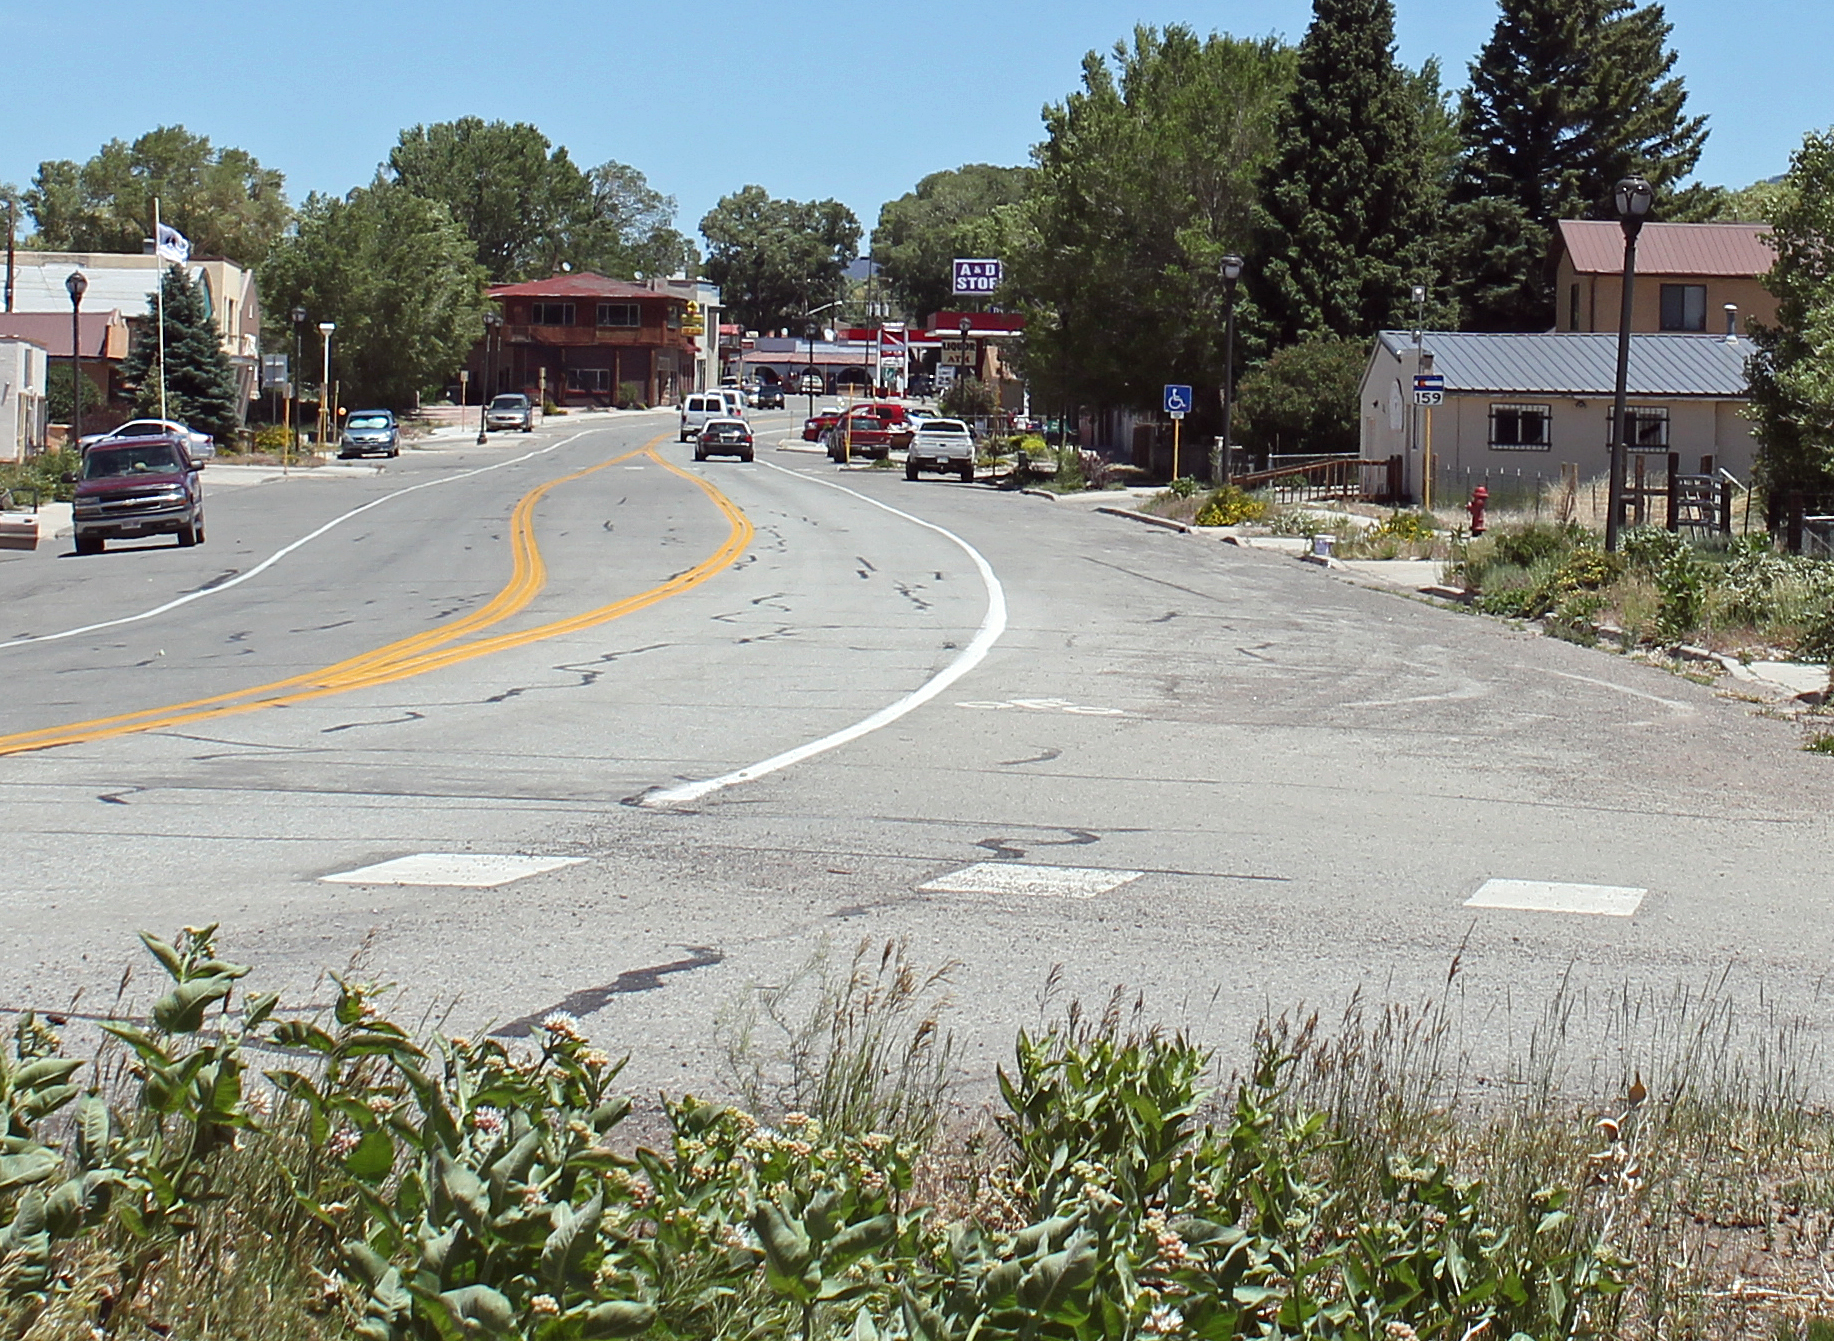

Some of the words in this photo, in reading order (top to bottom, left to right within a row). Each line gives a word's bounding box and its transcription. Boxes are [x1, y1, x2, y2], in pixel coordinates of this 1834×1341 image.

[960, 263, 971, 276] A
[974, 265, 981, 274] &
[985, 264, 995, 276] D
[942, 342, 976, 351] LIQUOR
[1415, 392, 1441, 404] 159
